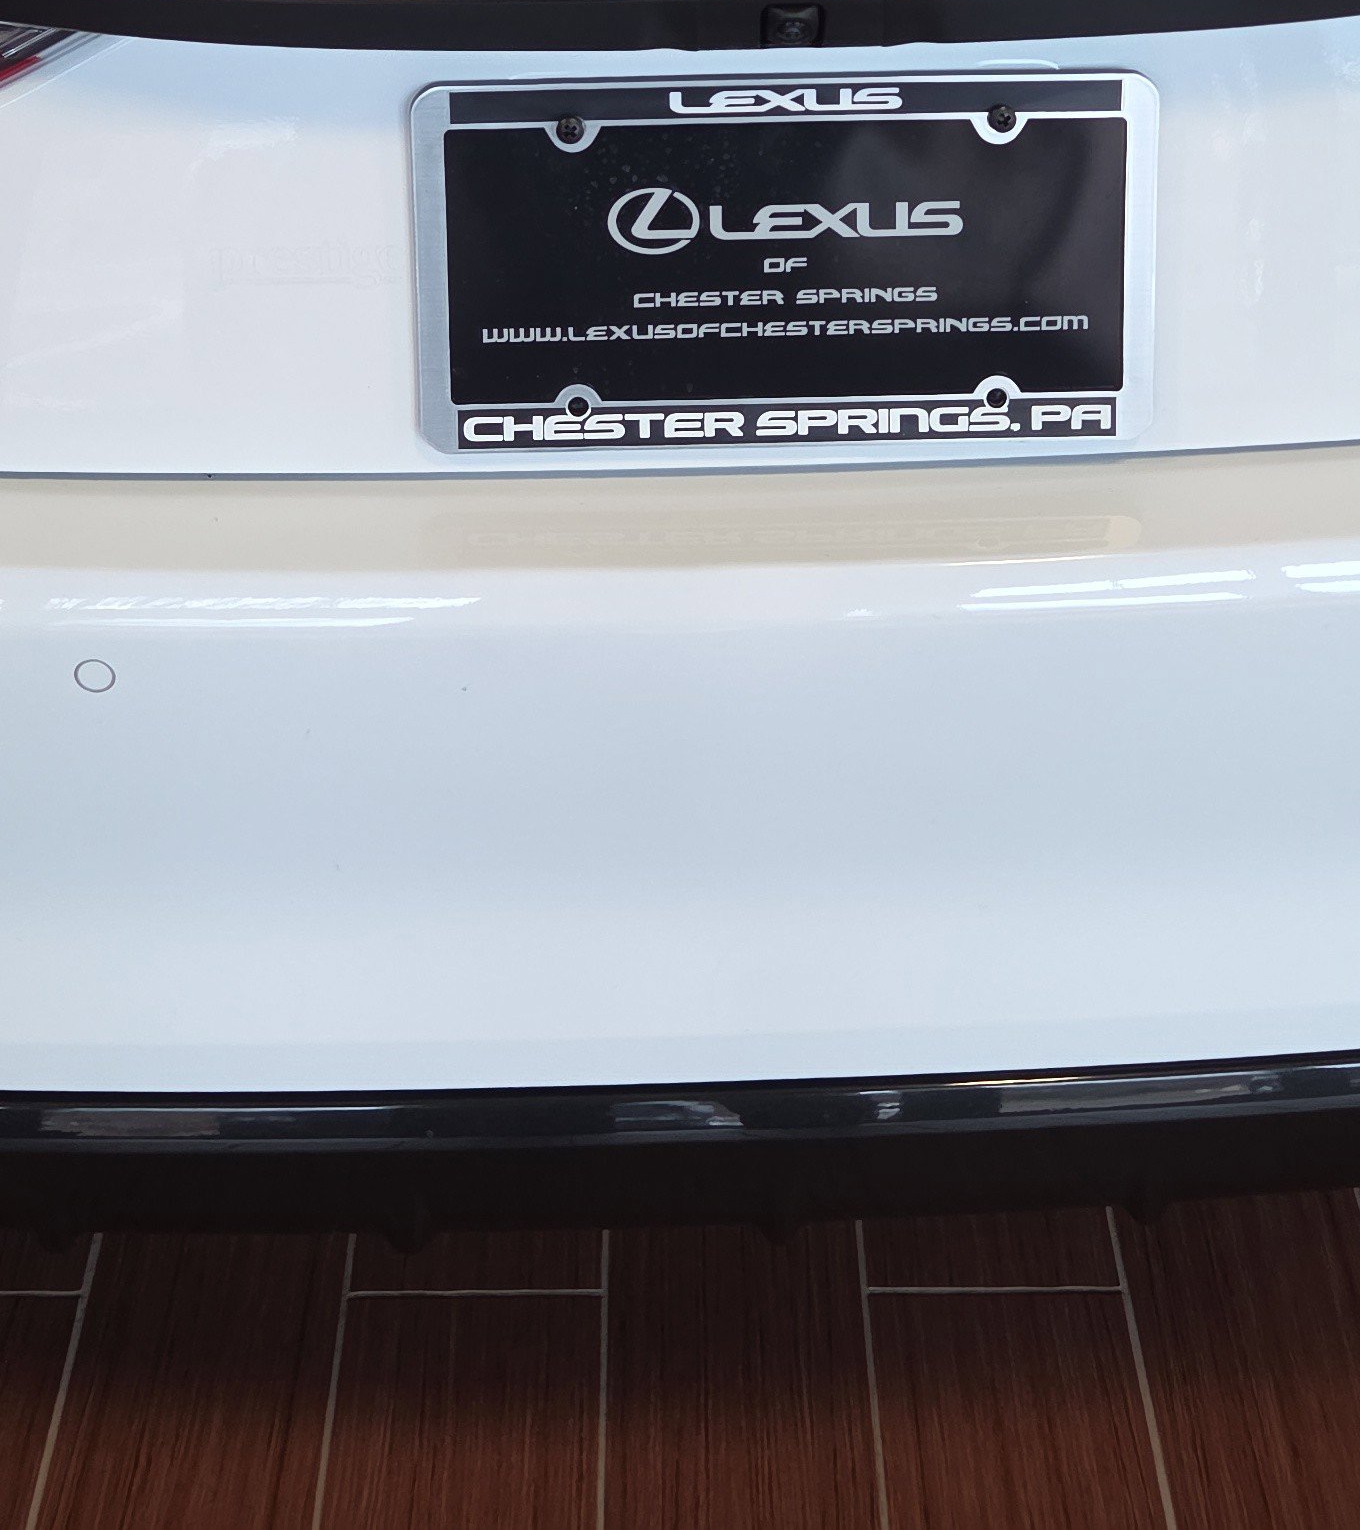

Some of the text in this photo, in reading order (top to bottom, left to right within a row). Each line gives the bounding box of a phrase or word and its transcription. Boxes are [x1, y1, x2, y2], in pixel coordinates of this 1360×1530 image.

[669, 86, 903, 115] LEXUS
[709, 200, 964, 241] LEXUS
[763, 257, 808, 274] OF
[633, 286, 938, 308] CHESTER SPRINGS
[462, 411, 745, 443] CHESTER
[1031, 404, 1112, 431] PA
